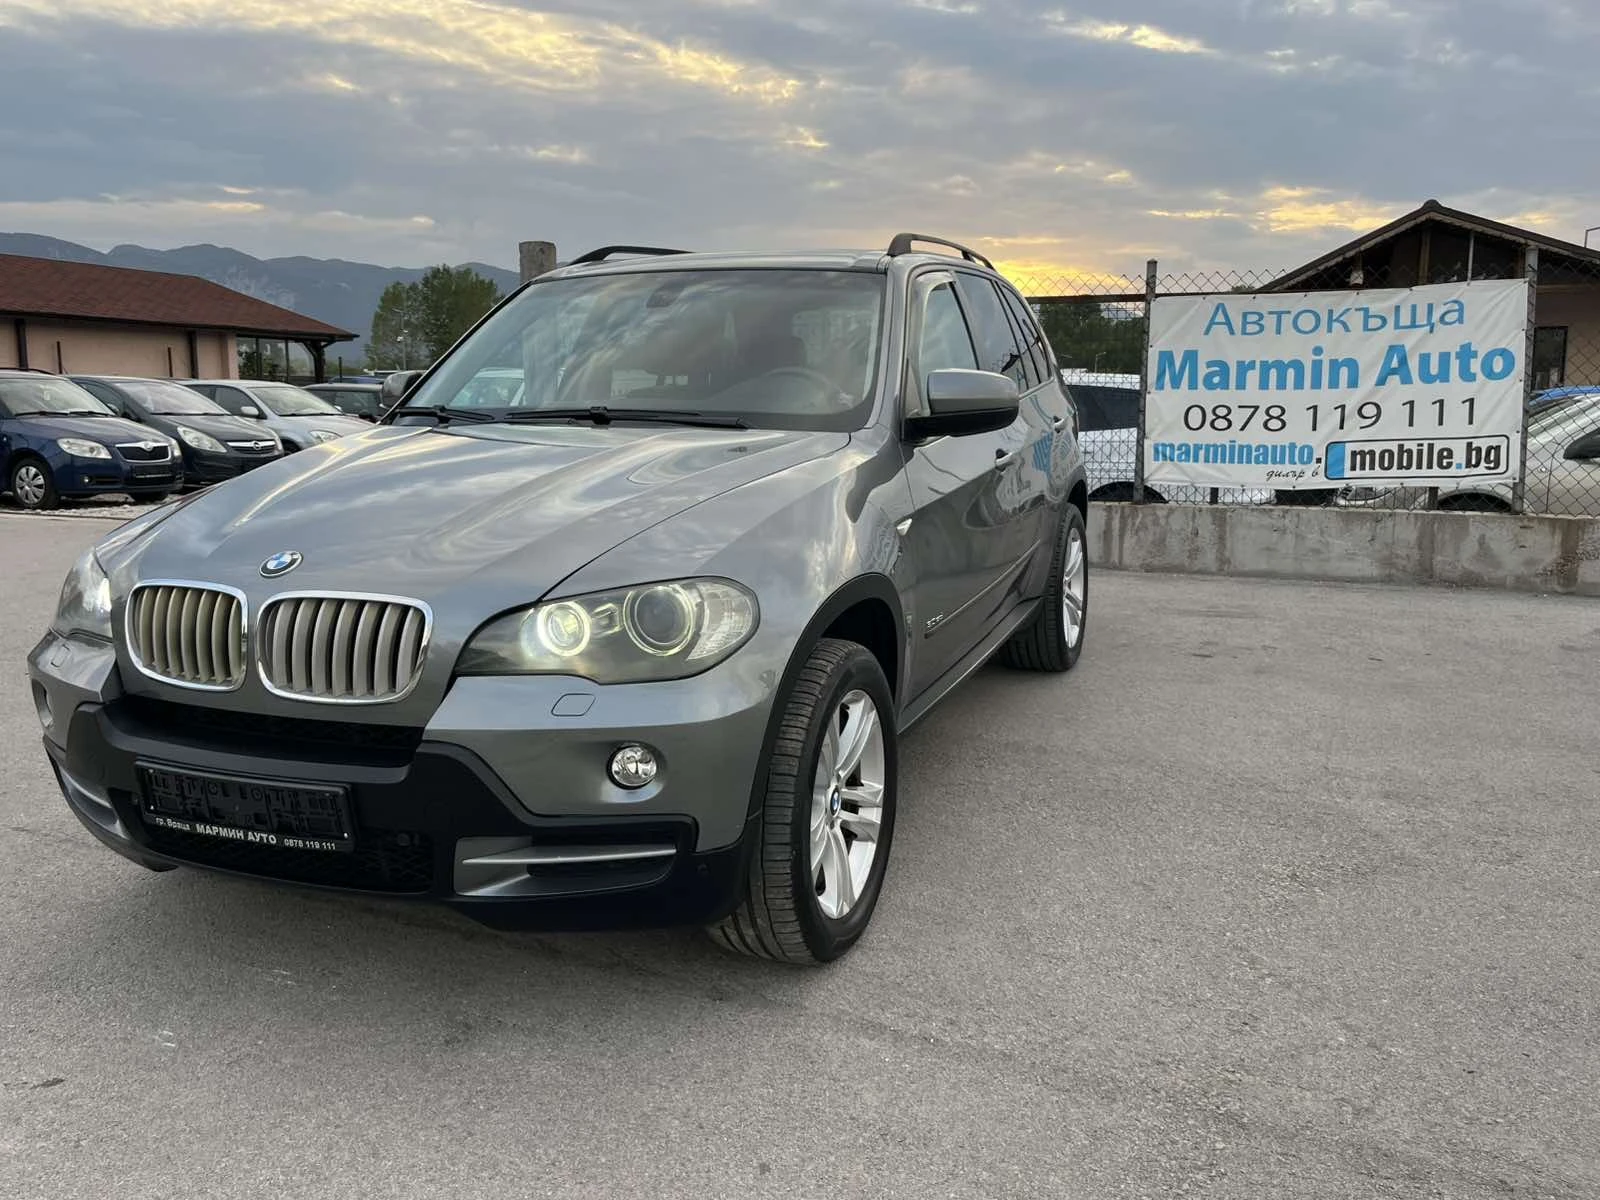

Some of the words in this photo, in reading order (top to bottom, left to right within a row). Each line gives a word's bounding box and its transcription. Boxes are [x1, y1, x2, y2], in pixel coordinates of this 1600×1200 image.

[1203, 299, 1465, 336] Автокъща
[1154, 345, 1360, 391] Marmin
[1374, 341, 1516, 387] Auto
[1183, 403, 1287, 432] 0878
[1305, 400, 1382, 431] 119
[1400, 397, 1477, 428] 111
[1349, 441, 1502, 471] mobile.bg
[195, 823, 245, 840] МАРМИН
[247, 831, 277, 845] АУТО
[322, 841, 336, 851] 111
